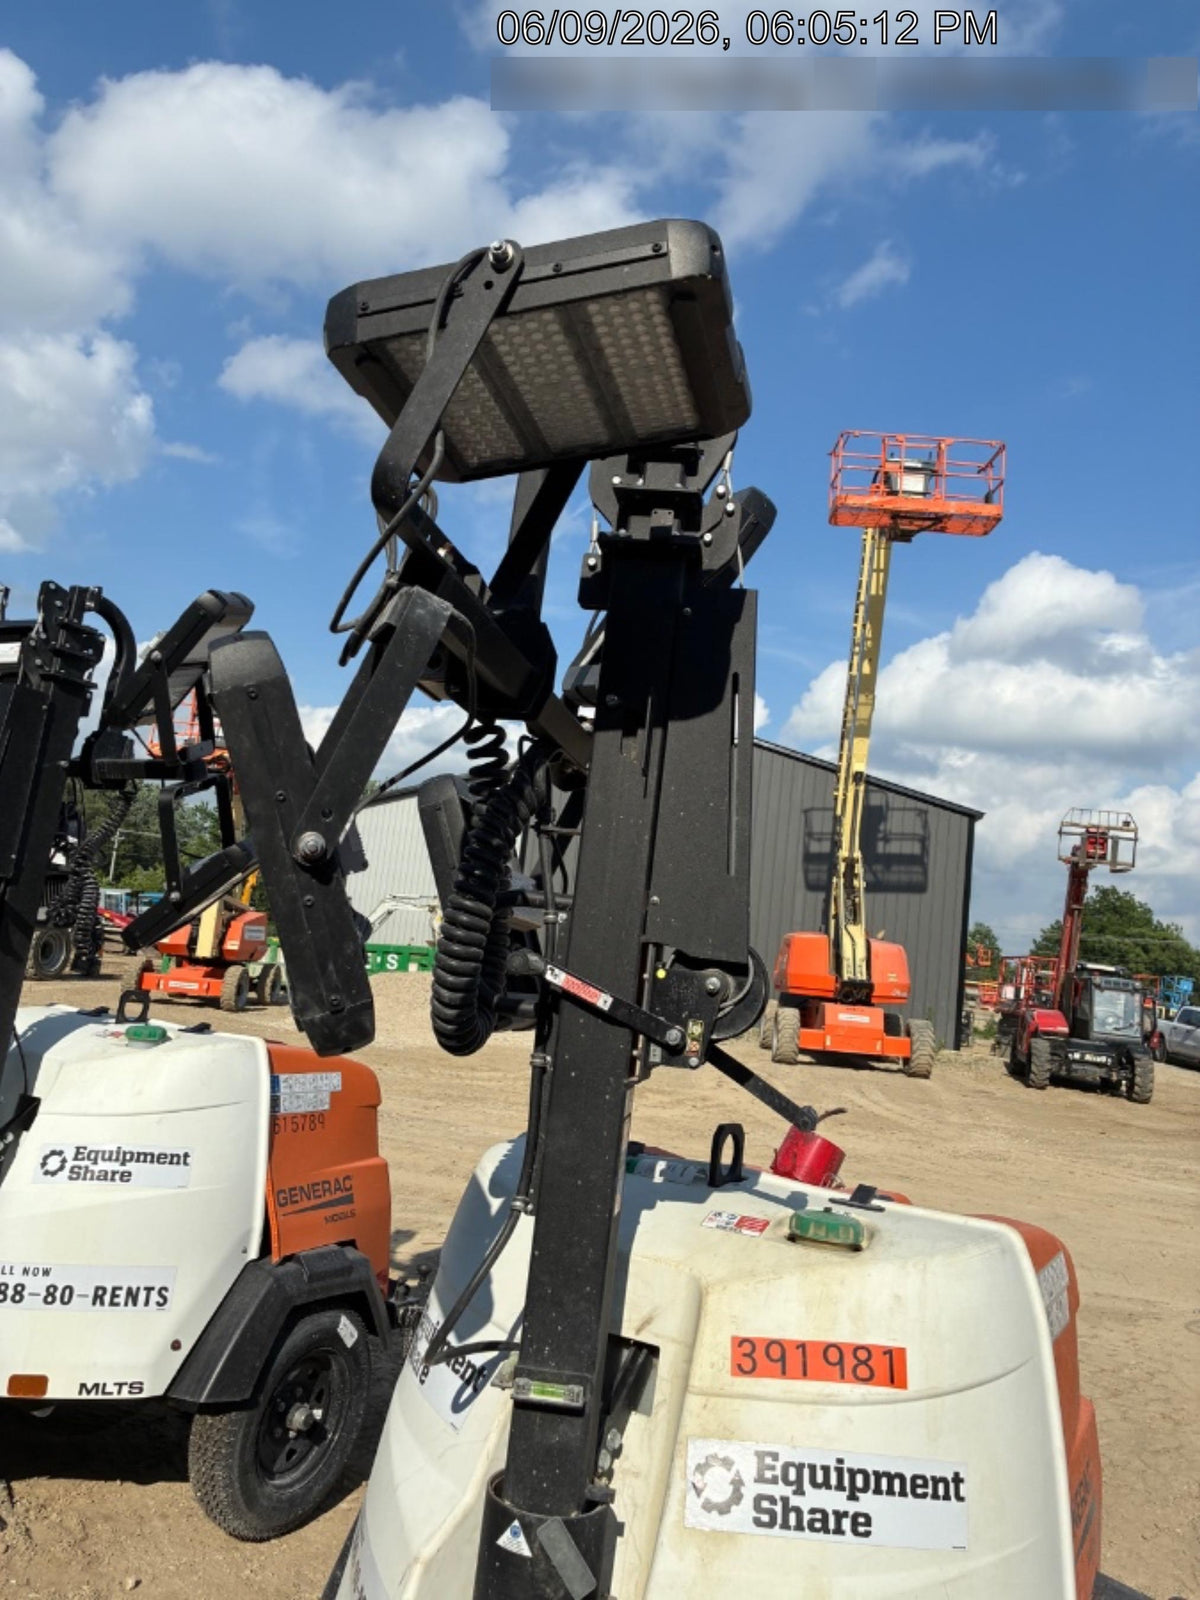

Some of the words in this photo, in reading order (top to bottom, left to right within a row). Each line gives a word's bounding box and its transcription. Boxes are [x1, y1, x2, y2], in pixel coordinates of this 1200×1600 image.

[272, 1113, 326, 1135] 615789
[72, 1146, 191, 1167] Equipment
[67, 1165, 132, 1183] Share
[276, 1174, 354, 1208] GENERAC
[22, 1266, 52, 1277] NOW
[737, 1338, 895, 1385] 391981
[78, 1381, 145, 1396] MLTS
[754, 1450, 966, 1503] Equipment
[752, 1493, 873, 1538] Share
